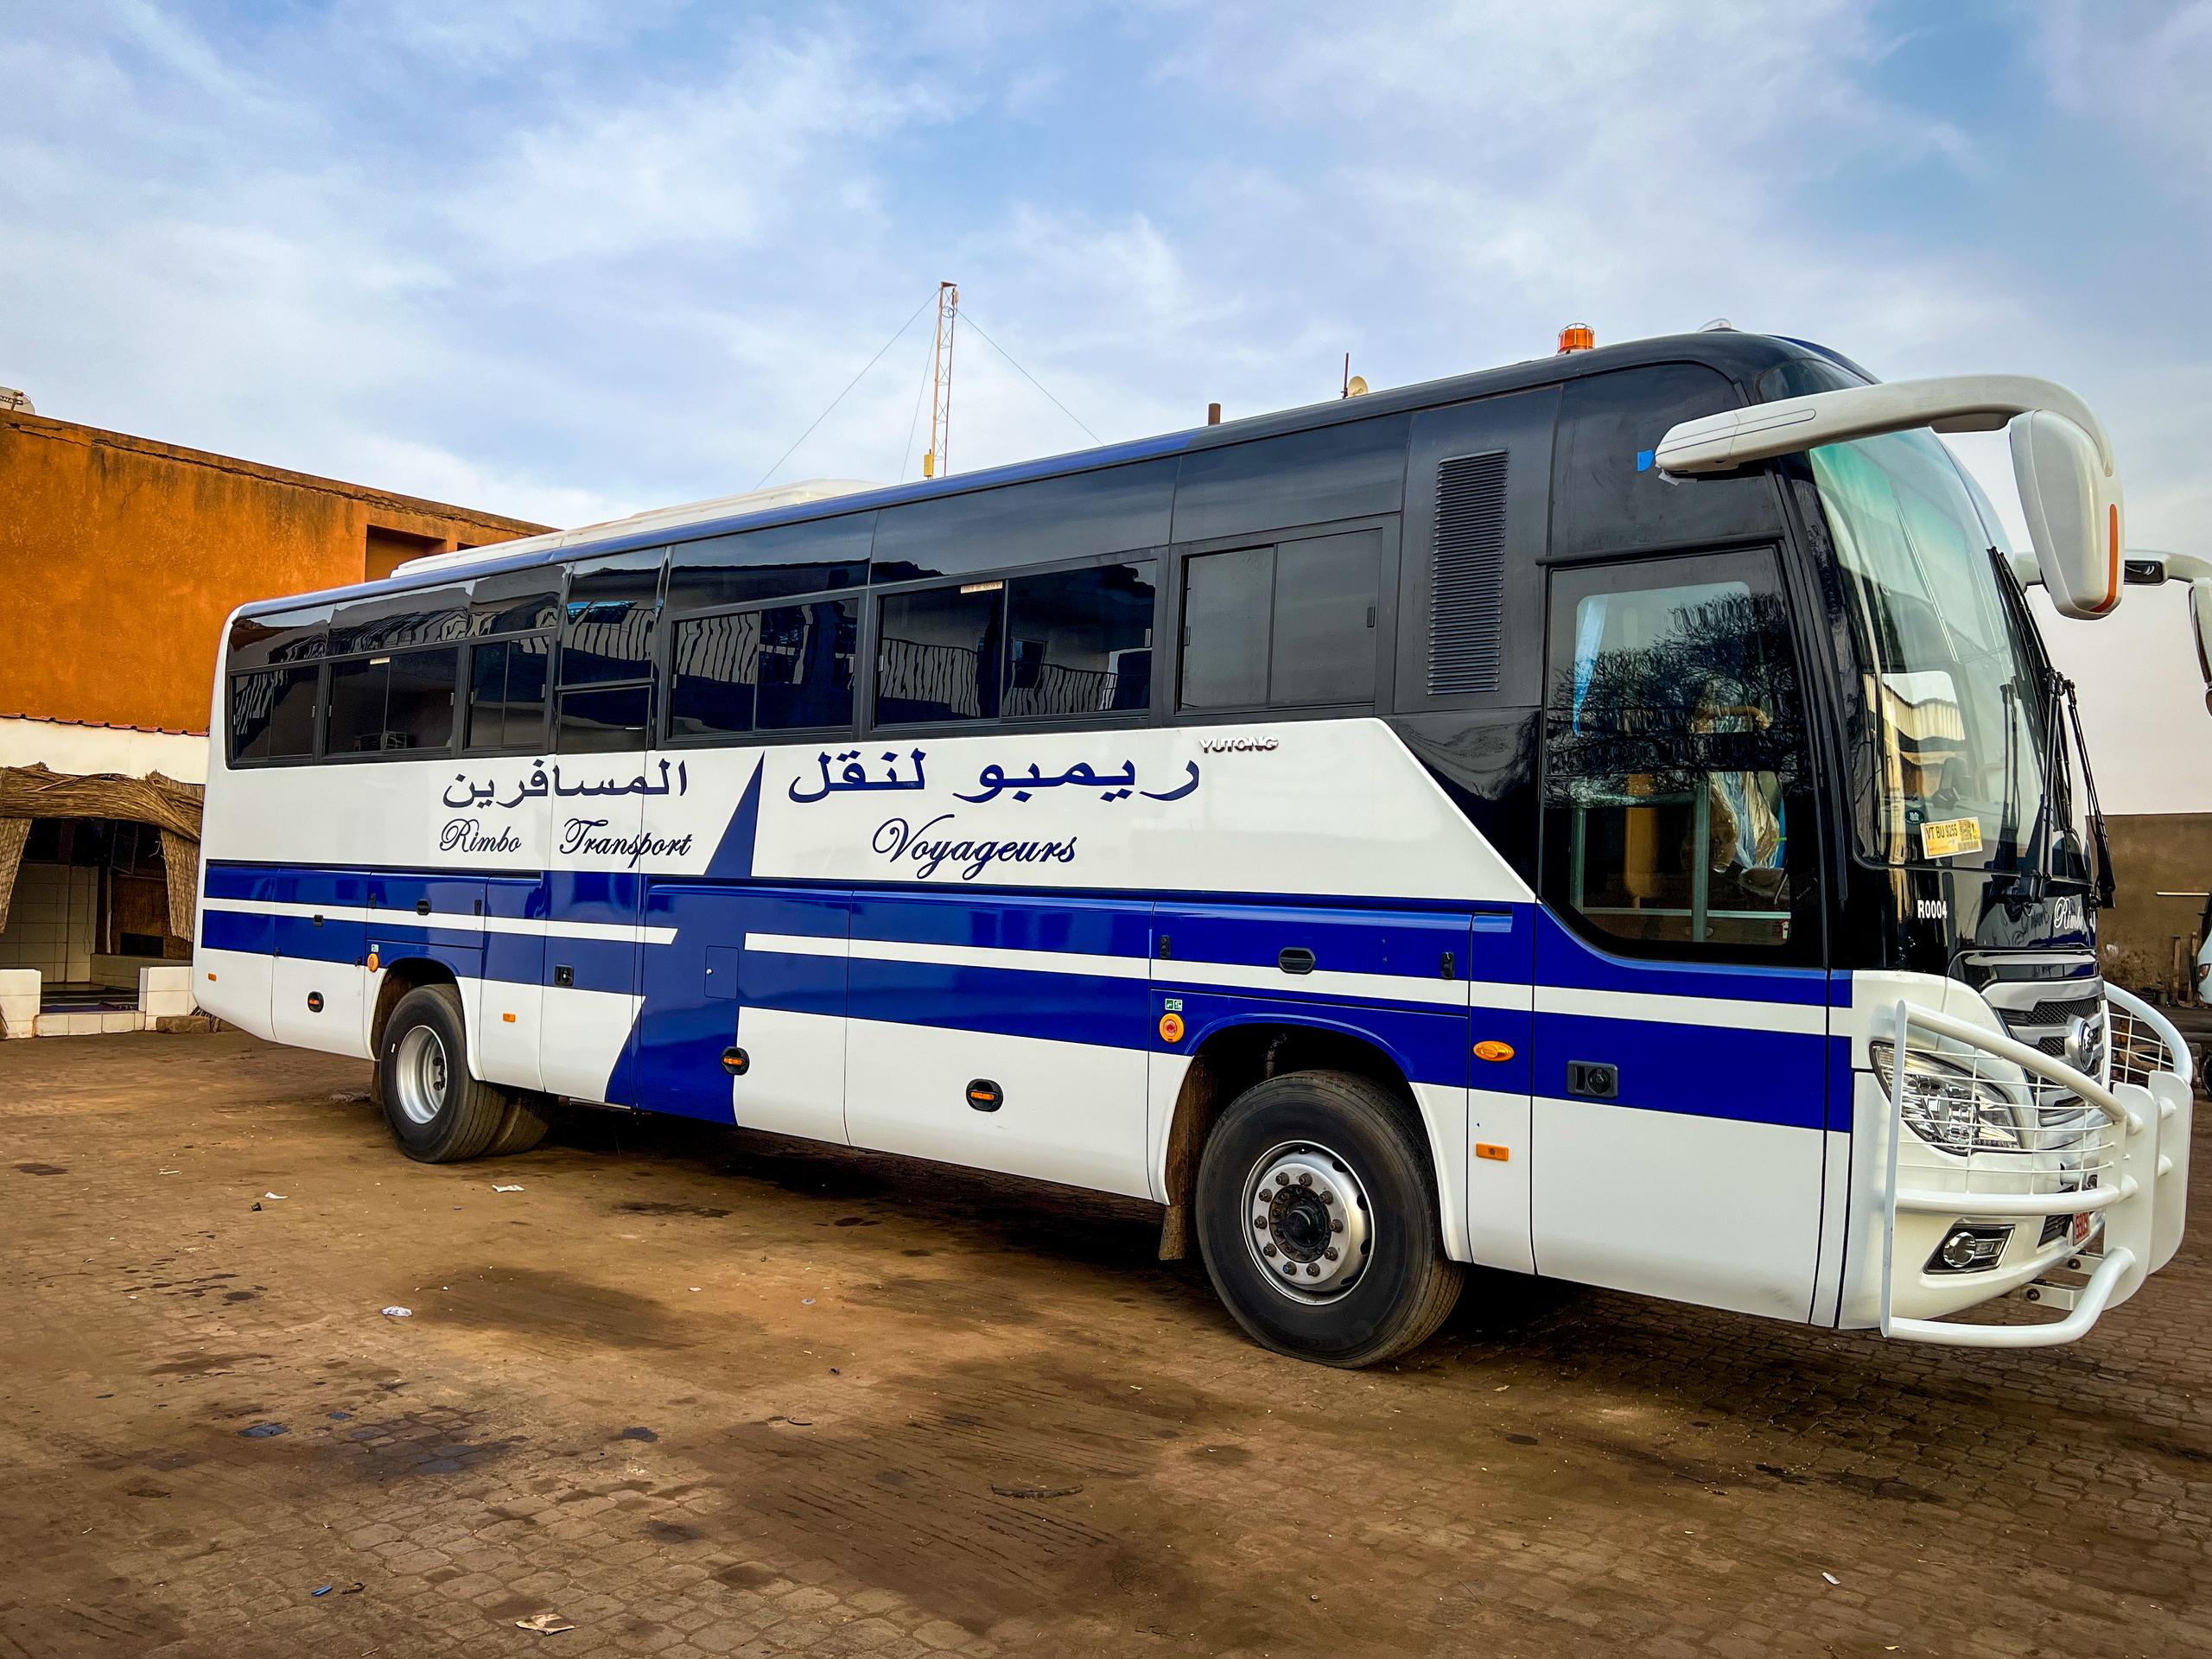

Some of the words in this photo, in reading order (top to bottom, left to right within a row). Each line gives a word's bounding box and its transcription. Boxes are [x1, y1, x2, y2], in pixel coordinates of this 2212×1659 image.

[1199, 736, 1279, 753] YUTONG
[442, 759, 688, 810] المسافرين
[788, 747, 927, 804] لنقل
[952, 760, 1200, 804] ريمبو
[439, 818, 522, 853] Rimbo
[559, 817, 692, 869] Transport
[872, 814, 1077, 880] Voyageurs
[1916, 899, 1948, 919] R0004
